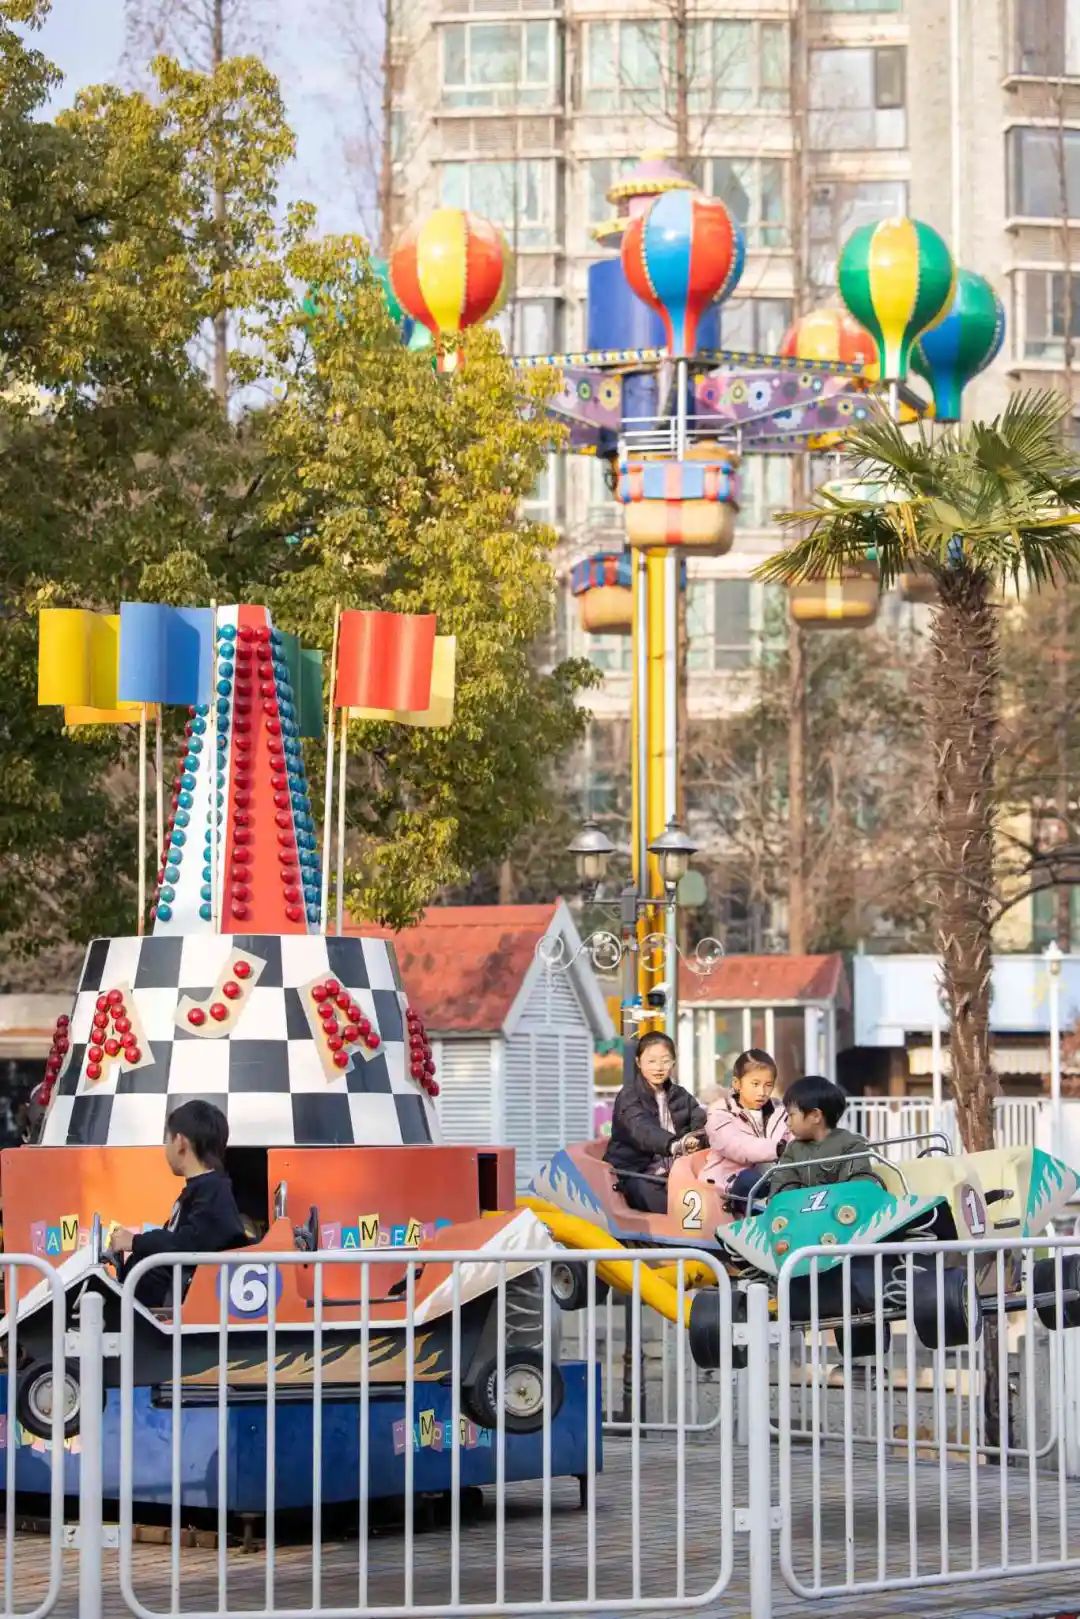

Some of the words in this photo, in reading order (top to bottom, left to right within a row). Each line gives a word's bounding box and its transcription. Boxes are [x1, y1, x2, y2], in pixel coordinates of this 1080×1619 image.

[682, 1190, 703, 1230] 2
[966, 1188, 985, 1234] 1
[229, 1263, 269, 1312] 6
